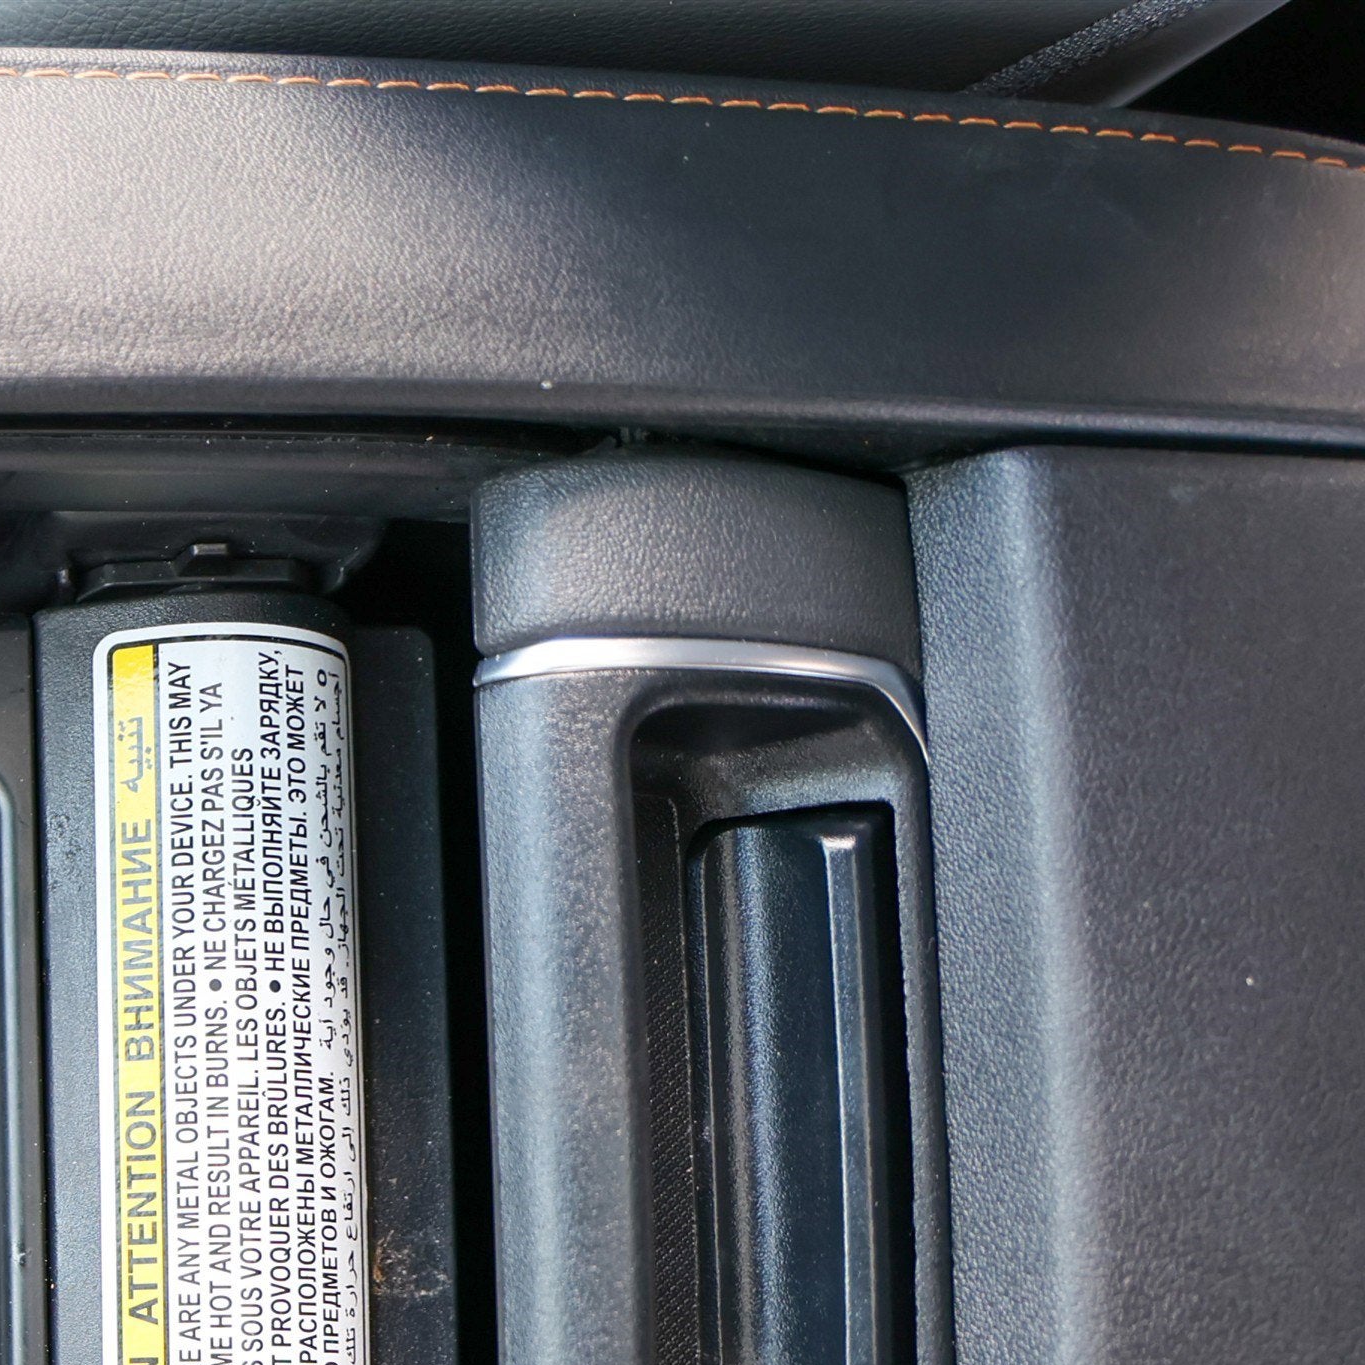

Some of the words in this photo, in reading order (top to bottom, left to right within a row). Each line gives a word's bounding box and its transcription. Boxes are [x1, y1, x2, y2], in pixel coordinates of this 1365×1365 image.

[166, 661, 193, 710] MAY
[198, 681, 223, 714] YA
[257, 649, 285, 761] ЗАРЯДКУ,
[284, 663, 307, 752] МОЖЕТ
[117, 717, 153, 793] تنبيه
[168, 715, 194, 770] THIS
[198, 718, 224, 761] S'IL
[286, 756, 308, 805] ЭТО
[169, 774, 195, 867] DEVICE.
[199, 767, 225, 813] PAS
[225, 747, 258, 911] MÉTALLIQUES
[200, 817, 227, 933] CHARGEZ
[259, 765, 285, 935] ВЫПОЛНЯЙТЕ
[287, 811, 314, 951] ПРЕДМЕТЫ.
[120, 819, 155, 1062] ВНИМАНИЕ
[170, 873, 196, 940] YOUR
[171, 945, 198, 1028] UNDER
[202, 939, 227, 971] NE
[233, 917, 259, 1011] OBJETS
[263, 940, 286, 973] НЕ
[203, 999, 230, 1088] BURNS.
[235, 1017, 260, 1062] LES
[259, 1001, 289, 1136] BRÛLURES.
[291, 957, 315, 1166] МЕТАЛЛИЧЕСКИЕ
[173, 1034, 199, 1144] OBJECTS
[205, 1096, 230, 1118] IN
[317, 1071, 337, 1179] ОЖОГАМ.
[206, 1125, 232, 1216] RESULT
[236, 1069, 262, 1194] APPAREIL.
[266, 1143, 291, 1190] DES
[124, 1091, 160, 1326] ATTENTION
[175, 1150, 200, 1229] METAL
[319, 1185, 338, 1202] И
[177, 1237, 201, 1286] ANY
[208, 1223, 232, 1274] AND
[238, 1200, 263, 1281] VOTRE
[268, 1197, 294, 1347] PROVOQUER
[295, 1172, 319, 1365] РАСПОЛОЖЕНЫ
[320, 1207, 343, 1355] ПРЕДМЕТОВ
[177, 1293, 202, 1342] ARE
[208, 1280, 234, 1329] HOT
[239, 1287, 264, 1353] SOUS
